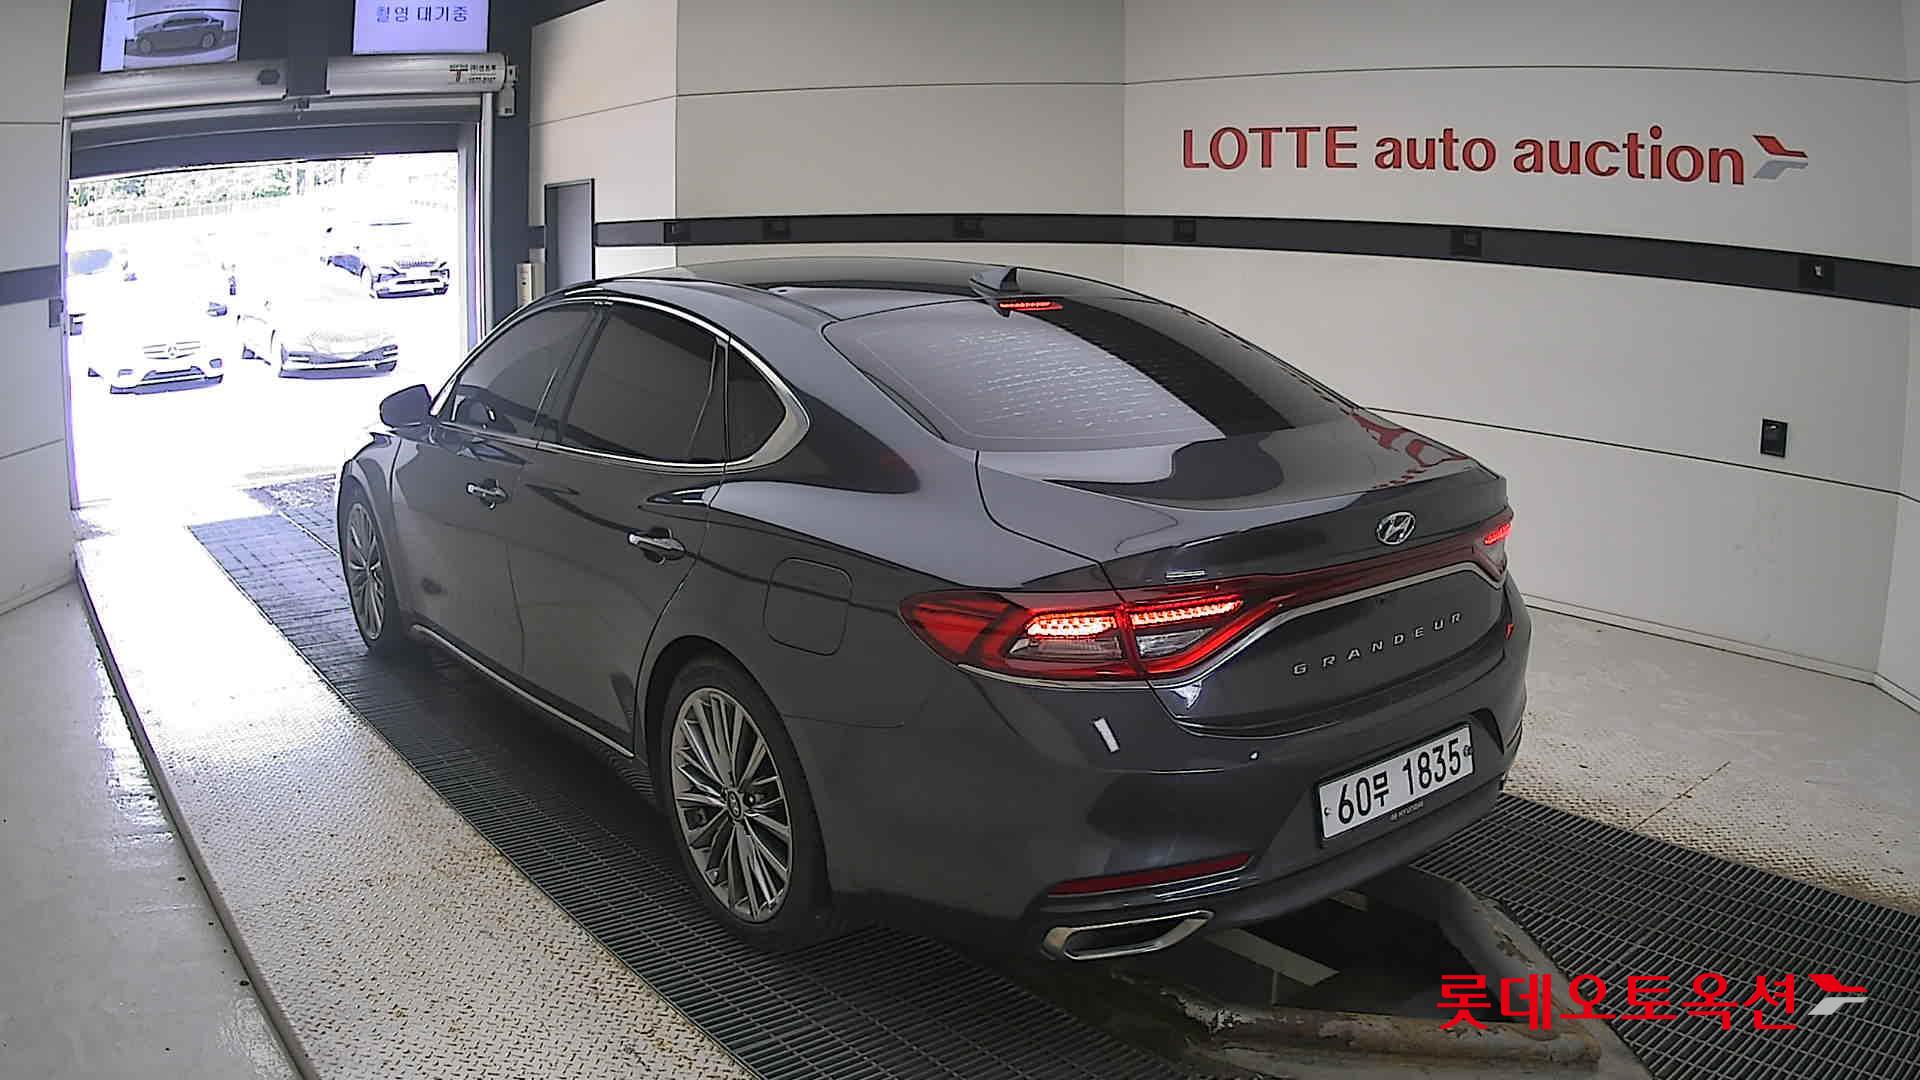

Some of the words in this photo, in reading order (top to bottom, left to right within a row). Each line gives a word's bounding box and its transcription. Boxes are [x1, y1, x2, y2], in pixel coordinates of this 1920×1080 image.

[417, 5, 468, 22] 대기중
[1182, 125, 1359, 170] LOTTE
[1374, 127, 1497, 172] auto
[1513, 124, 1746, 186] auction
[1292, 612, 1463, 675] GRANDEUR
[1337, 770, 1390, 825] 60무
[1402, 738, 1461, 796] 1835
